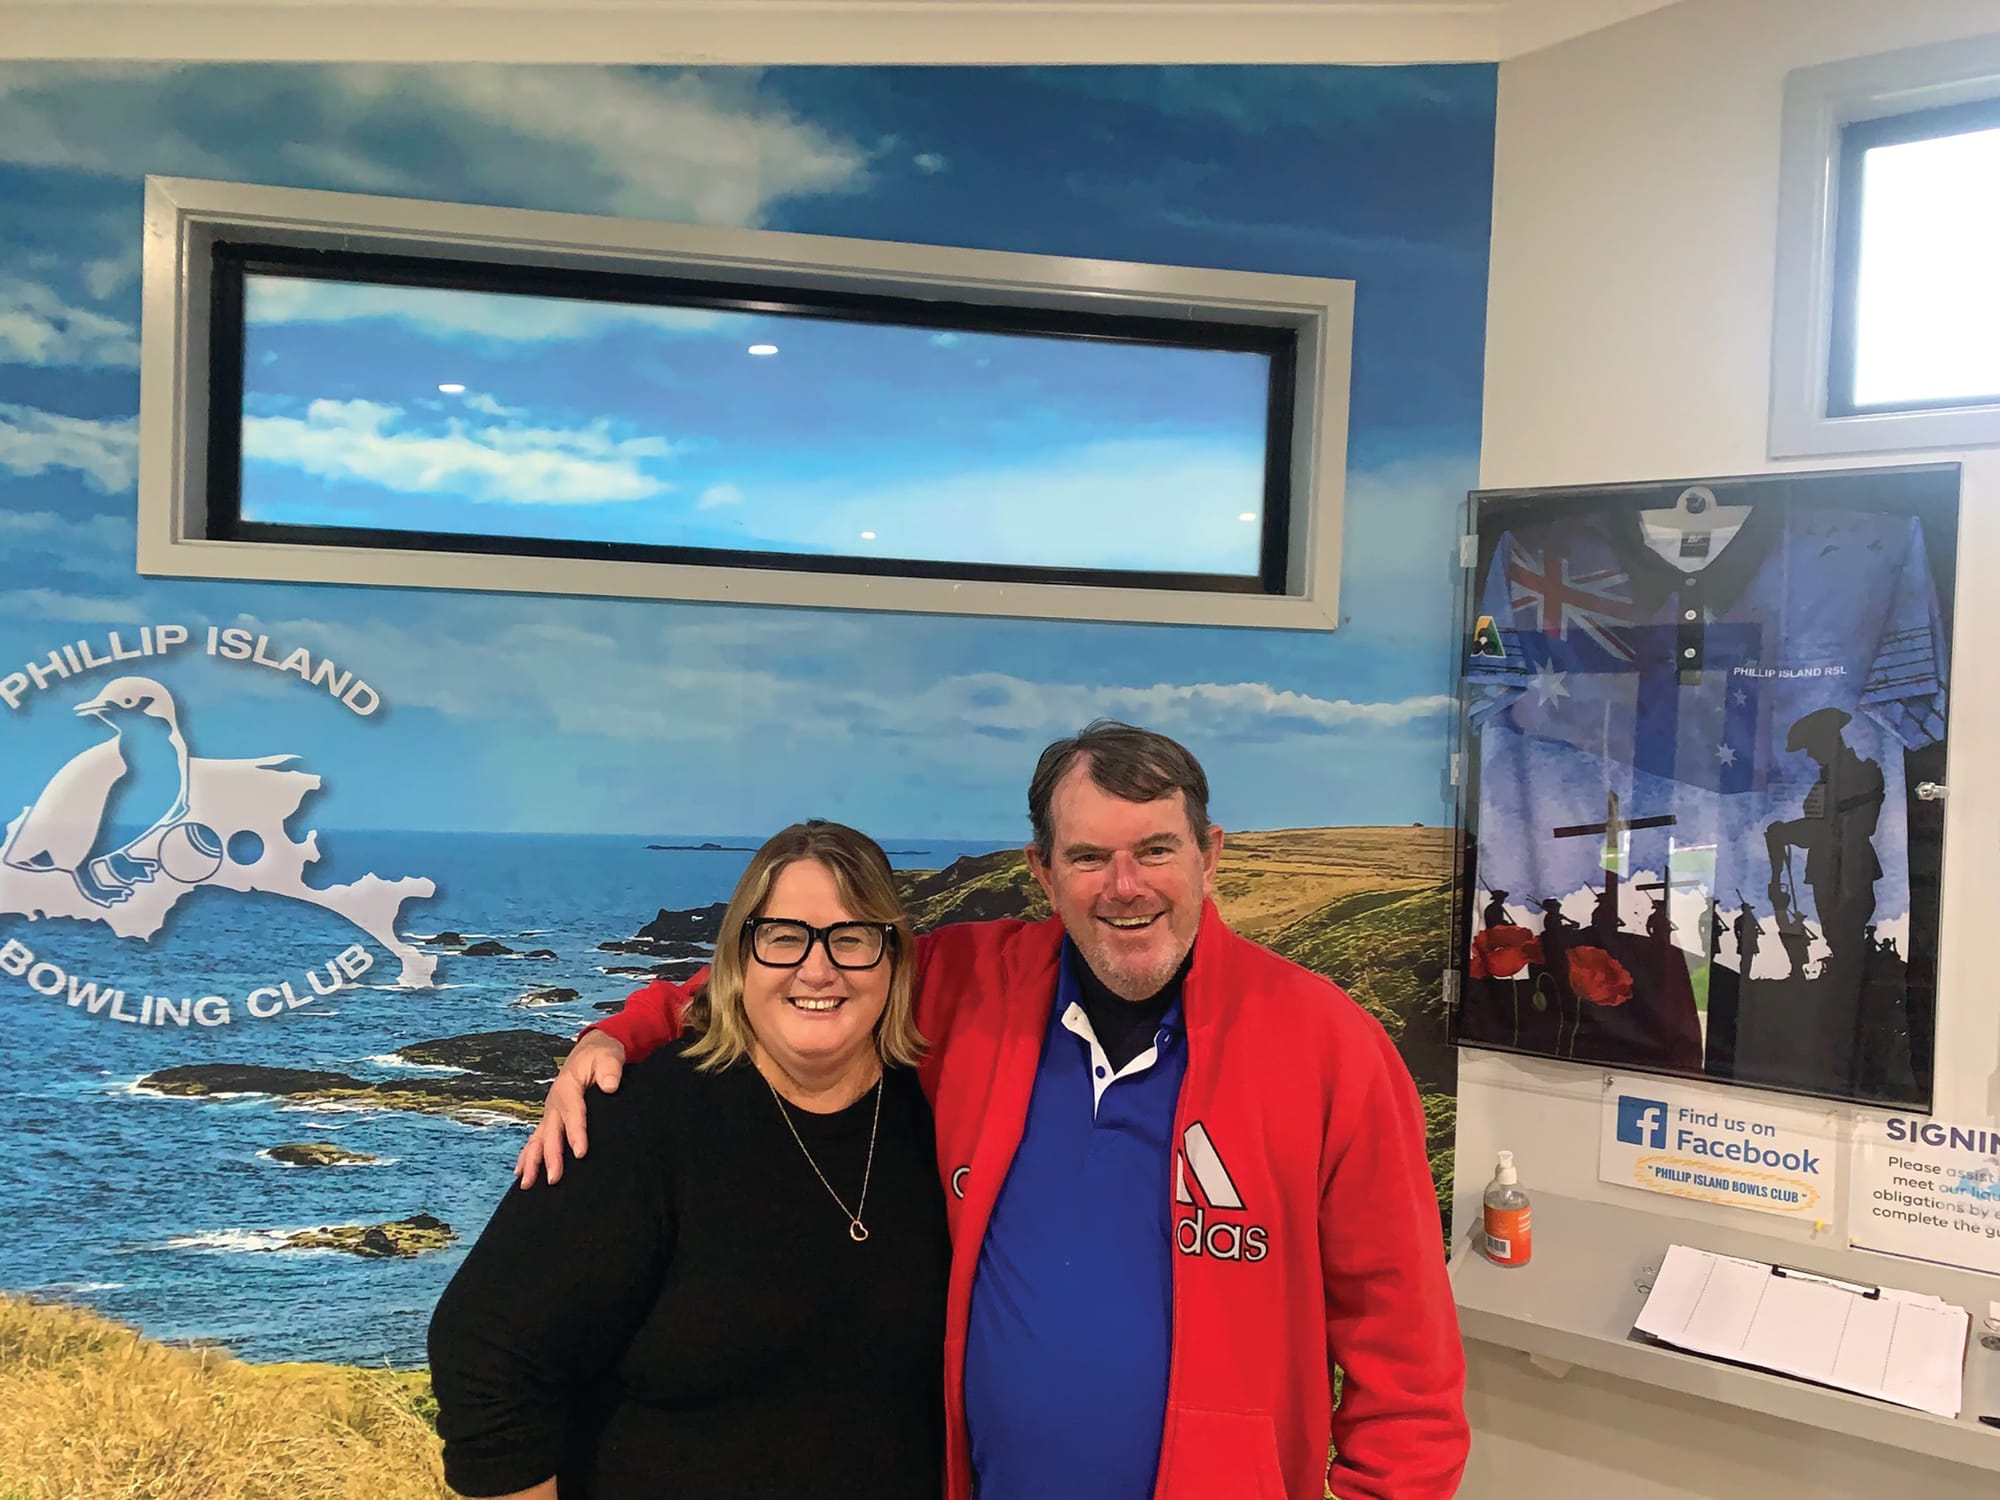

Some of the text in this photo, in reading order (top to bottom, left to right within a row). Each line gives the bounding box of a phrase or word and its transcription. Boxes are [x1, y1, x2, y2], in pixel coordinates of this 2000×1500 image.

[0, 624, 380, 717] PHILLIP ISLAND
[1733, 665, 1847, 678] PHILLIP ISLAND RSL
[0, 937, 375, 1027] BOWLING CLUB
[1678, 1108, 1776, 1137] Find us on
[1677, 1129, 1820, 1175] Facebook
[1655, 1166, 1799, 1203] PHILLIP ISLAND BOWLS CLUB
[1888, 1156, 1995, 1184] Please assist
[1893, 1176, 1935, 1191] meet
[1939, 1184, 1967, 1195] our
[1873, 1189, 1965, 1214] obligations
[1969, 1203, 1989, 1219] by
[1872, 1207, 1949, 1228] complete
[1954, 1219, 1981, 1234] the
